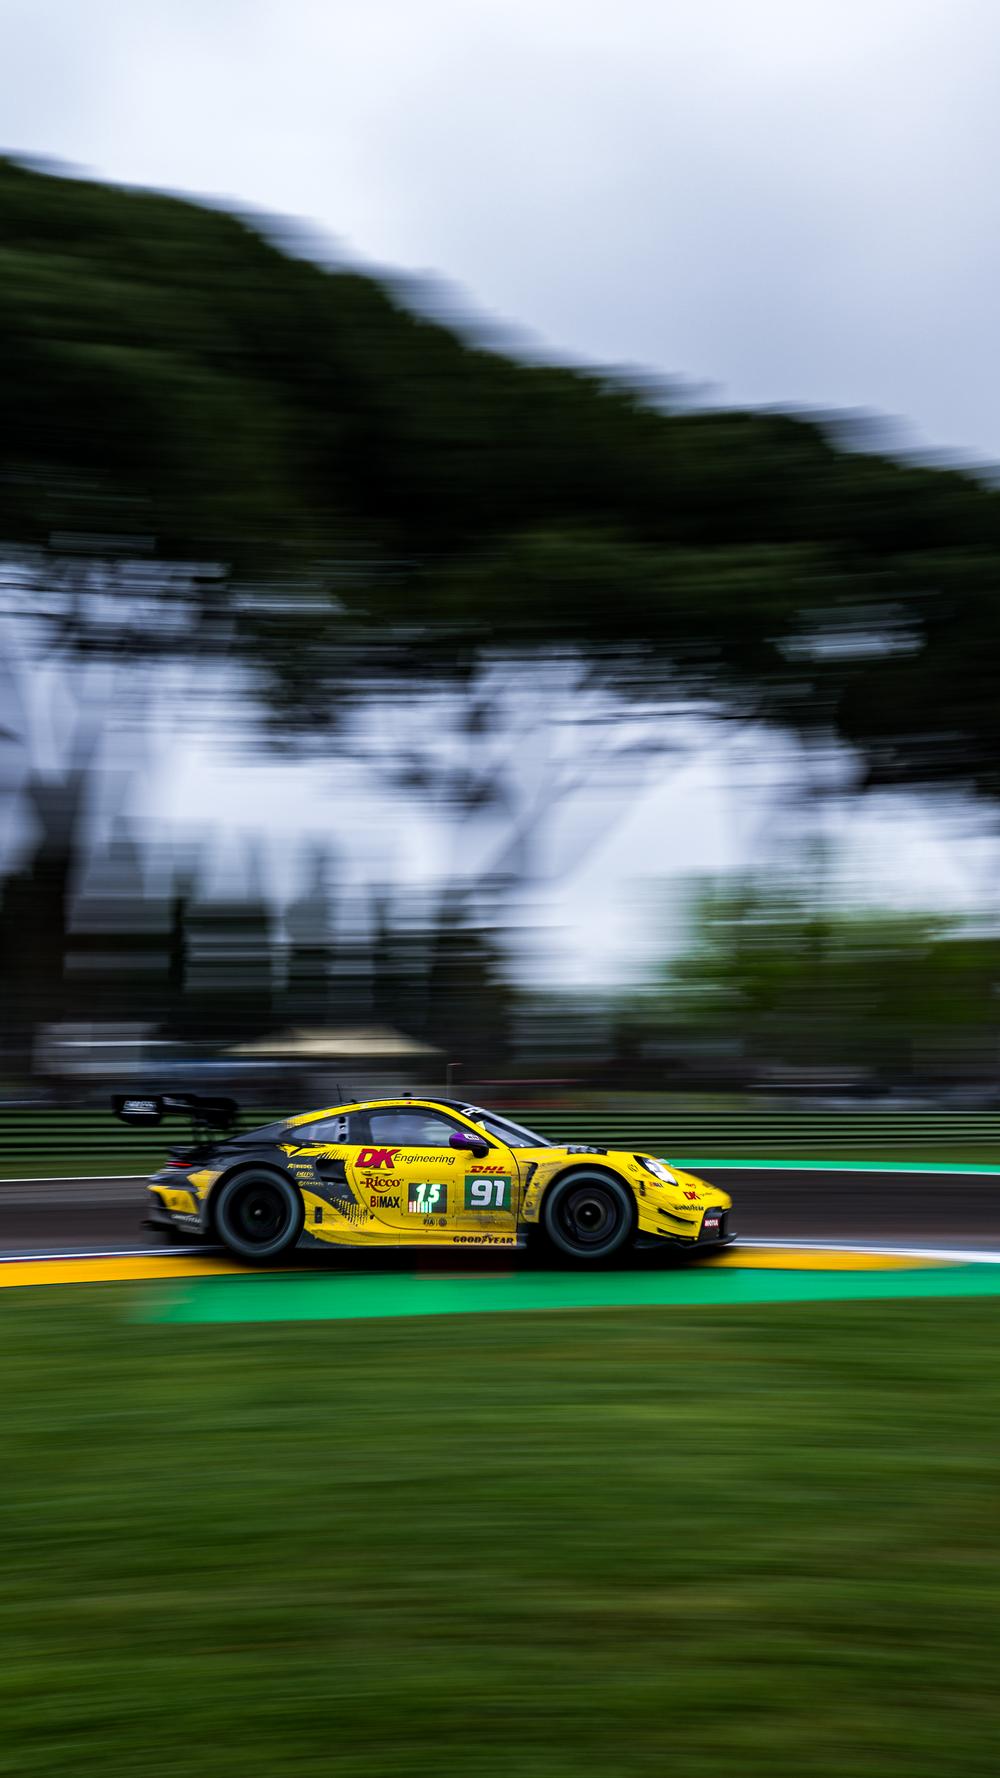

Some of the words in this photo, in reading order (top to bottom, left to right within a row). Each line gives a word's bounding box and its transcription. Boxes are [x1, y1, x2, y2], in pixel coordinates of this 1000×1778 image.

[355, 1148, 401, 1168] DK
[394, 1153, 456, 1165] Engineering
[470, 1165, 506, 1174] DHL
[365, 1176, 400, 1193] Ricco
[416, 1183, 441, 1203] 15
[370, 1195, 400, 1208] BiMAX
[470, 1180, 505, 1207] 91
[453, 1233, 514, 1244] GOODYEAR
